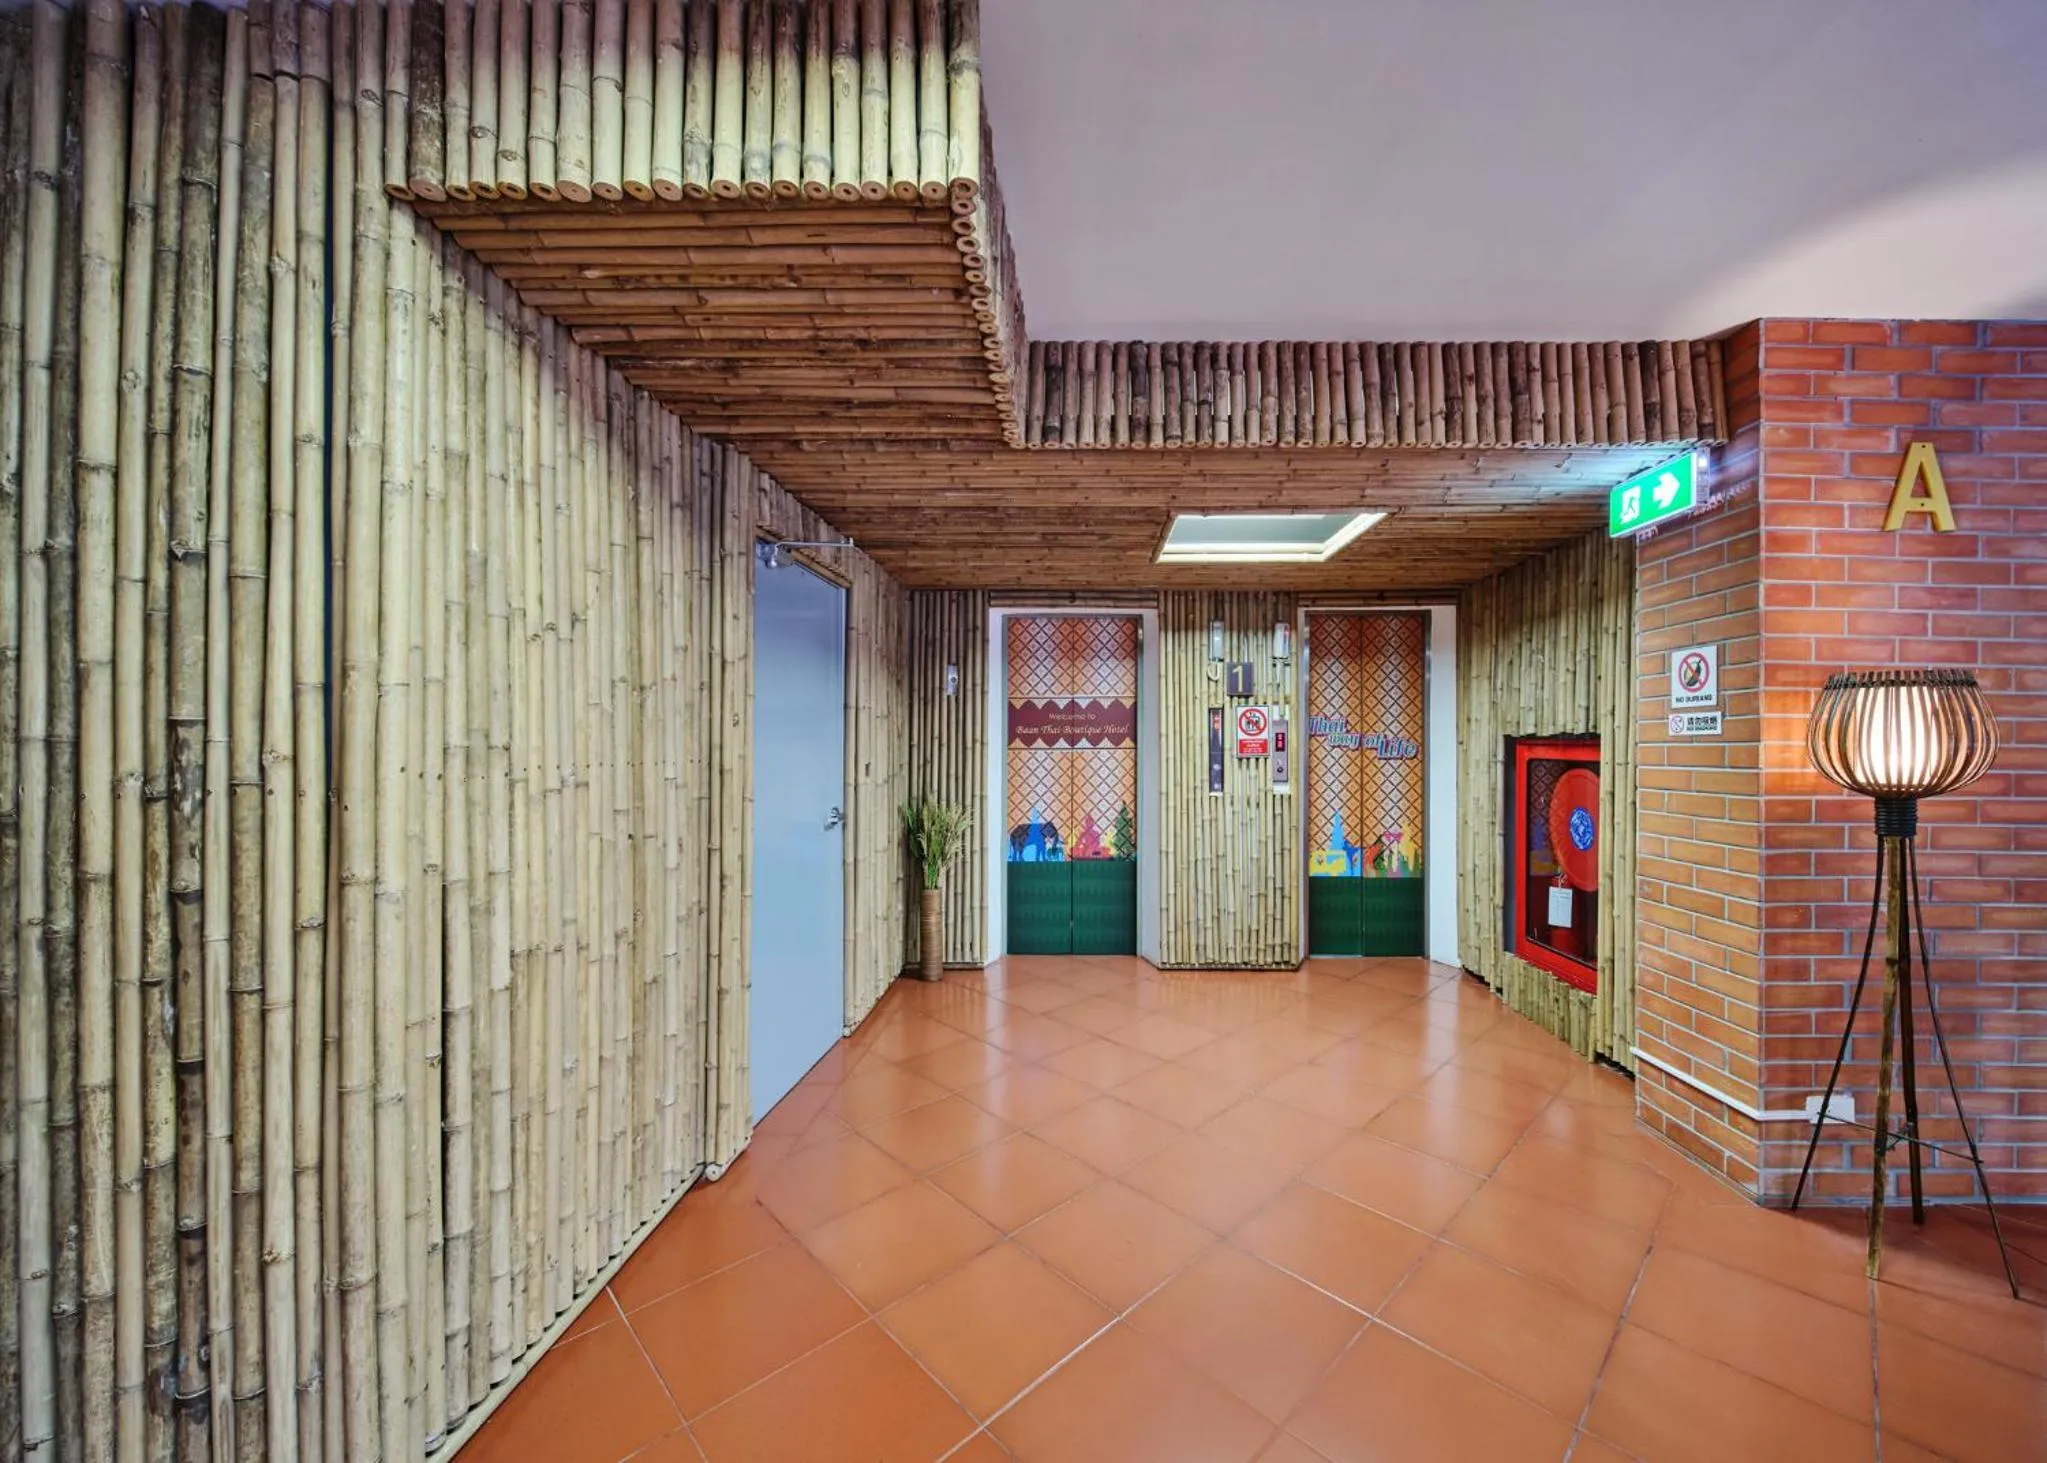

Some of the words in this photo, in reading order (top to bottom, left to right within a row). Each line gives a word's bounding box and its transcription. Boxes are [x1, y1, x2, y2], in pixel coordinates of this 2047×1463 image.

[1883, 441, 1957, 532] A
[1232, 664, 1244, 693] 1
[1049, 712, 1086, 721] Welcome
[1087, 712, 1097, 721] to
[1309, 714, 1346, 735] Thai
[1016, 725, 1039, 735] Baan
[1041, 724, 1061, 735] Thai
[1063, 724, 1102, 738] Boutique
[1104, 722, 1130, 735] Hotel
[1329, 732, 1360, 750] way
[1364, 732, 1384, 748] of
[1378, 737, 1419, 759] Life
